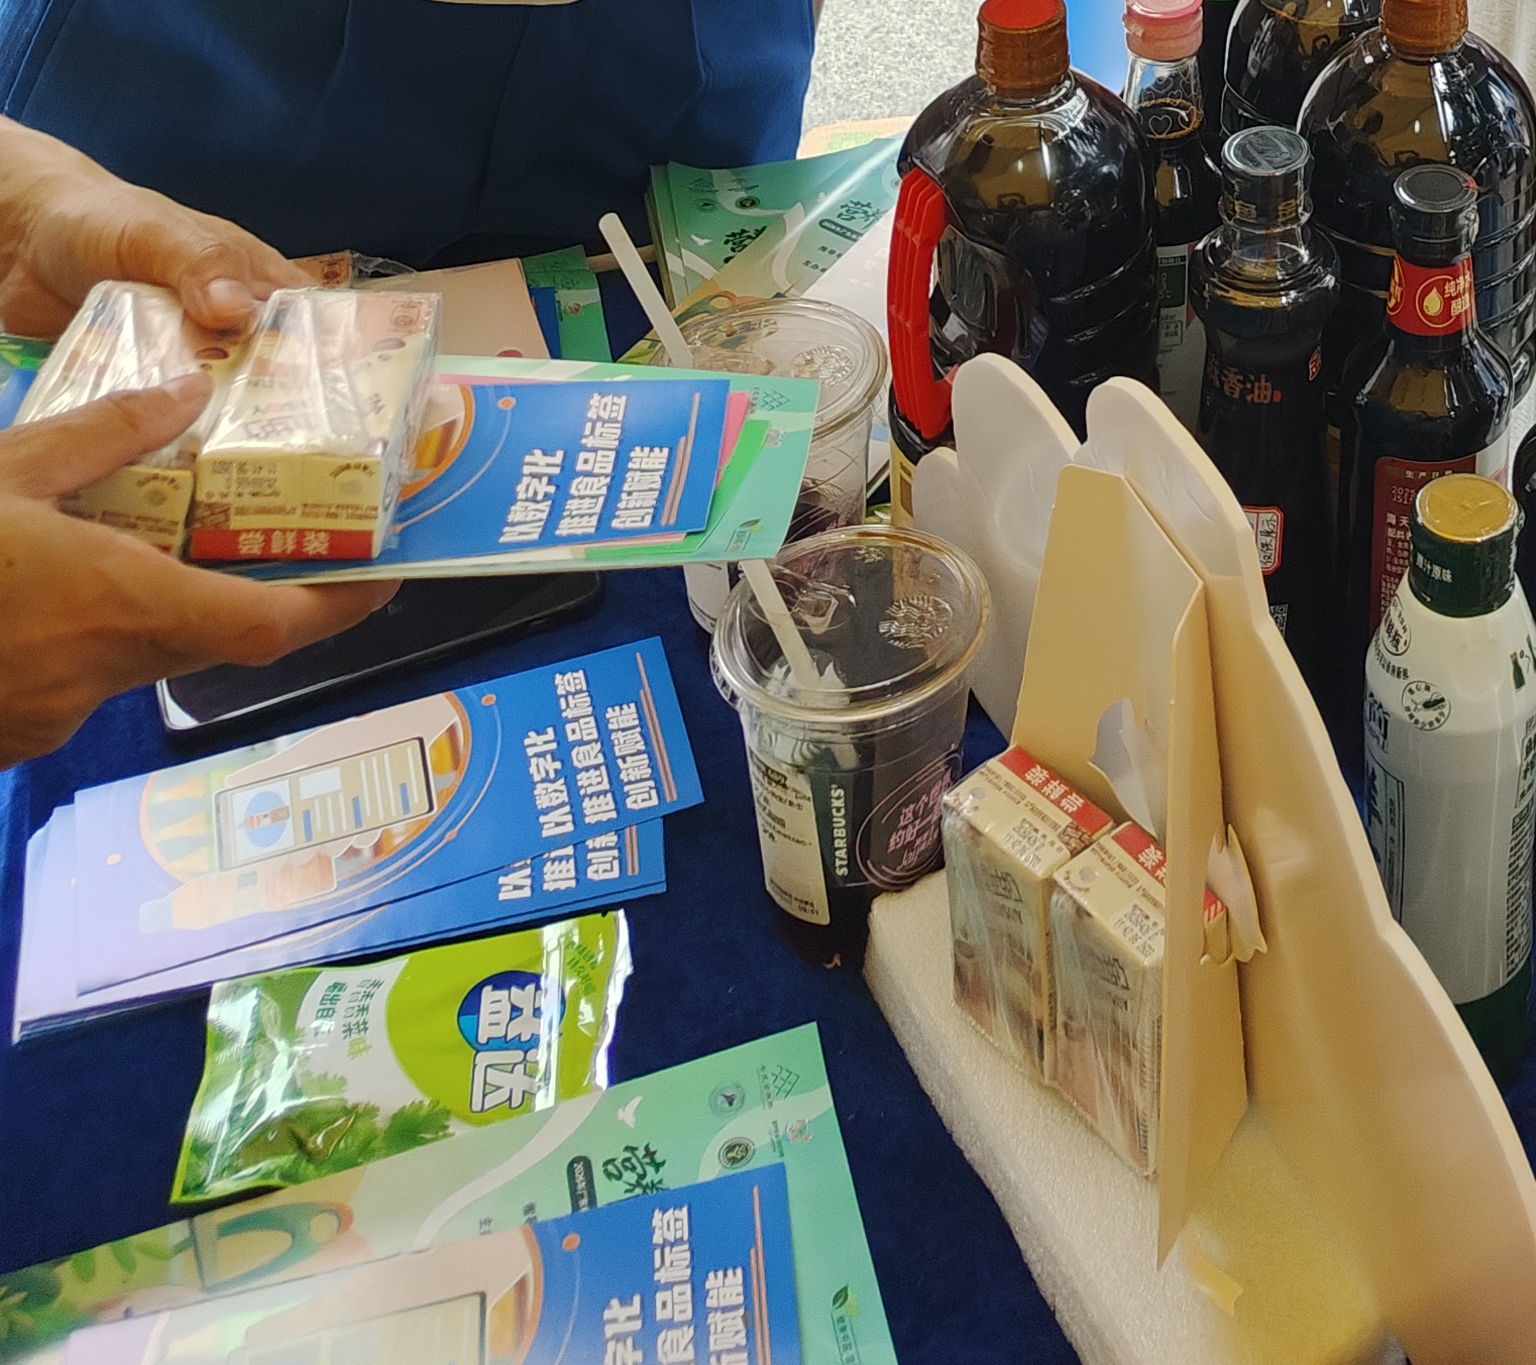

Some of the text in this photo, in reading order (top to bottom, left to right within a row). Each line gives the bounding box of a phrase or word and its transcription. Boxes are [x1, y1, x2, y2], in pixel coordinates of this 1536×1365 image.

[498, 448, 565, 544] 以数字化
[555, 392, 628, 540] 推进食品标签
[610, 444, 671, 531] 创新赋能
[523, 725, 578, 839] 以数字化
[554, 668, 618, 826] 推进食品标签
[605, 702, 660, 813] 创新赋能
[828, 783, 850, 879] STARBUCKS
[468, 983, 544, 1115] 益达
